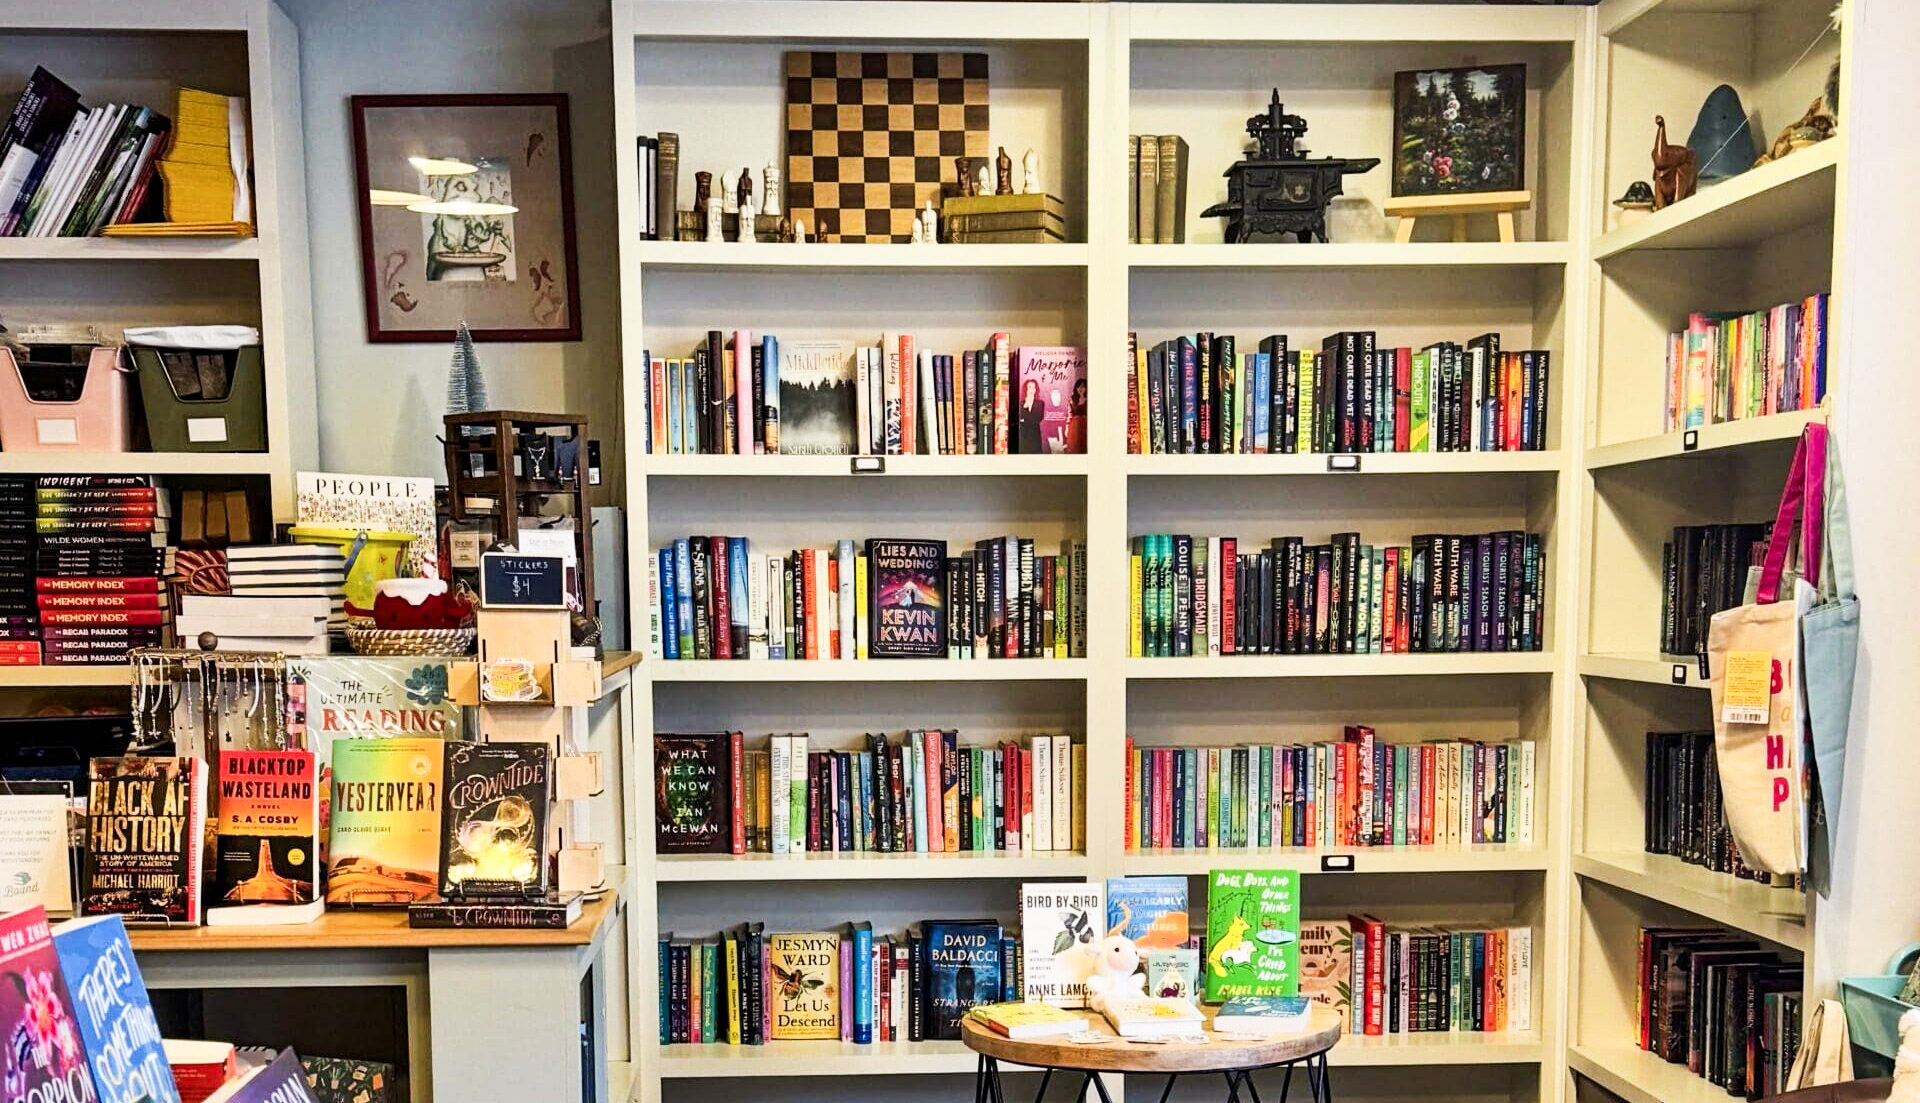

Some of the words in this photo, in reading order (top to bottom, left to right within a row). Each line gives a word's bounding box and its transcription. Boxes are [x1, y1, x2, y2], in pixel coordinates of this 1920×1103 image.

[1024, 357, 1087, 374] Marjorie
[1302, 366, 1312, 397] SLOW
[1302, 400, 1312, 443] HORSES
[40, 477, 91, 486] INDIGENT
[316, 478, 418, 498] PEOPLE
[881, 546, 906, 557] LIES
[908, 546, 937, 558] AND
[1296, 544, 1301, 555] WE
[1434, 539, 1442, 566] RUTH
[1450, 540, 1459, 566] RUTH
[500, 560, 548, 569] STICKERS
[879, 558, 940, 570] WEDDINGS
[1178, 540, 1187, 580] LOUISE
[1361, 558, 1369, 575] BIG
[692, 552, 704, 586] SIRENS
[1021, 544, 1033, 593] WHIDBEY
[52, 581, 94, 589] MEMORY
[97, 580, 124, 589] INDEX
[512, 576, 530, 597] $4
[977, 573, 985, 602] HITCH
[1434, 568, 1442, 596] WARE
[1450, 568, 1458, 597] WARE
[53, 598, 95, 606] MEMORY
[98, 598, 125, 606] INDEX
[796, 595, 801, 604] TO
[1195, 578, 1206, 634] BRIDESMAID
[100, 614, 128, 622] INDEX
[882, 608, 936, 626] KEVIN
[1179, 598, 1187, 636] PENNY
[1358, 602, 1367, 634] WOOL
[880, 626, 937, 643] KWAN
[340, 681, 362, 692] THE
[320, 692, 382, 704] ULTIMATE
[322, 708, 446, 732] READING
[669, 750, 707, 759] WHAT
[230, 758, 305, 775] BLACKTOP
[661, 766, 681, 775] WE
[688, 766, 716, 775] CAN
[223, 780, 311, 800] WASTELAND
[450, 759, 544, 808] CROWNTIDE
[669, 782, 709, 791] KNOW
[90, 781, 154, 816] BLACK
[163, 780, 190, 816] AF
[337, 782, 436, 812] YESTERYEAR
[676, 808, 703, 816] IAN
[91, 816, 186, 852] HISTORY
[661, 824, 718, 833] McEWAN
[92, 874, 134, 888] MICHAEL
[138, 874, 180, 888] HARRIOT
[1027, 896, 1051, 908] BIRD
[1056, 896, 1068, 908] BY
[1073, 896, 1098, 908] BIRD
[944, 934, 986, 946] DAVID
[1300, 926, 1332, 945] mily
[776, 940, 837, 950] JESMYN
[1300, 944, 1335, 958] enry
[783, 955, 830, 965] WARD
[932, 949, 998, 962] BALDACCI
[1029, 984, 1056, 996] ANNE
[784, 1000, 807, 1011] Let
[813, 1000, 829, 1011] Us
[933, 998, 994, 1008] STRANGRS
[778, 1015, 835, 1026] Descend
